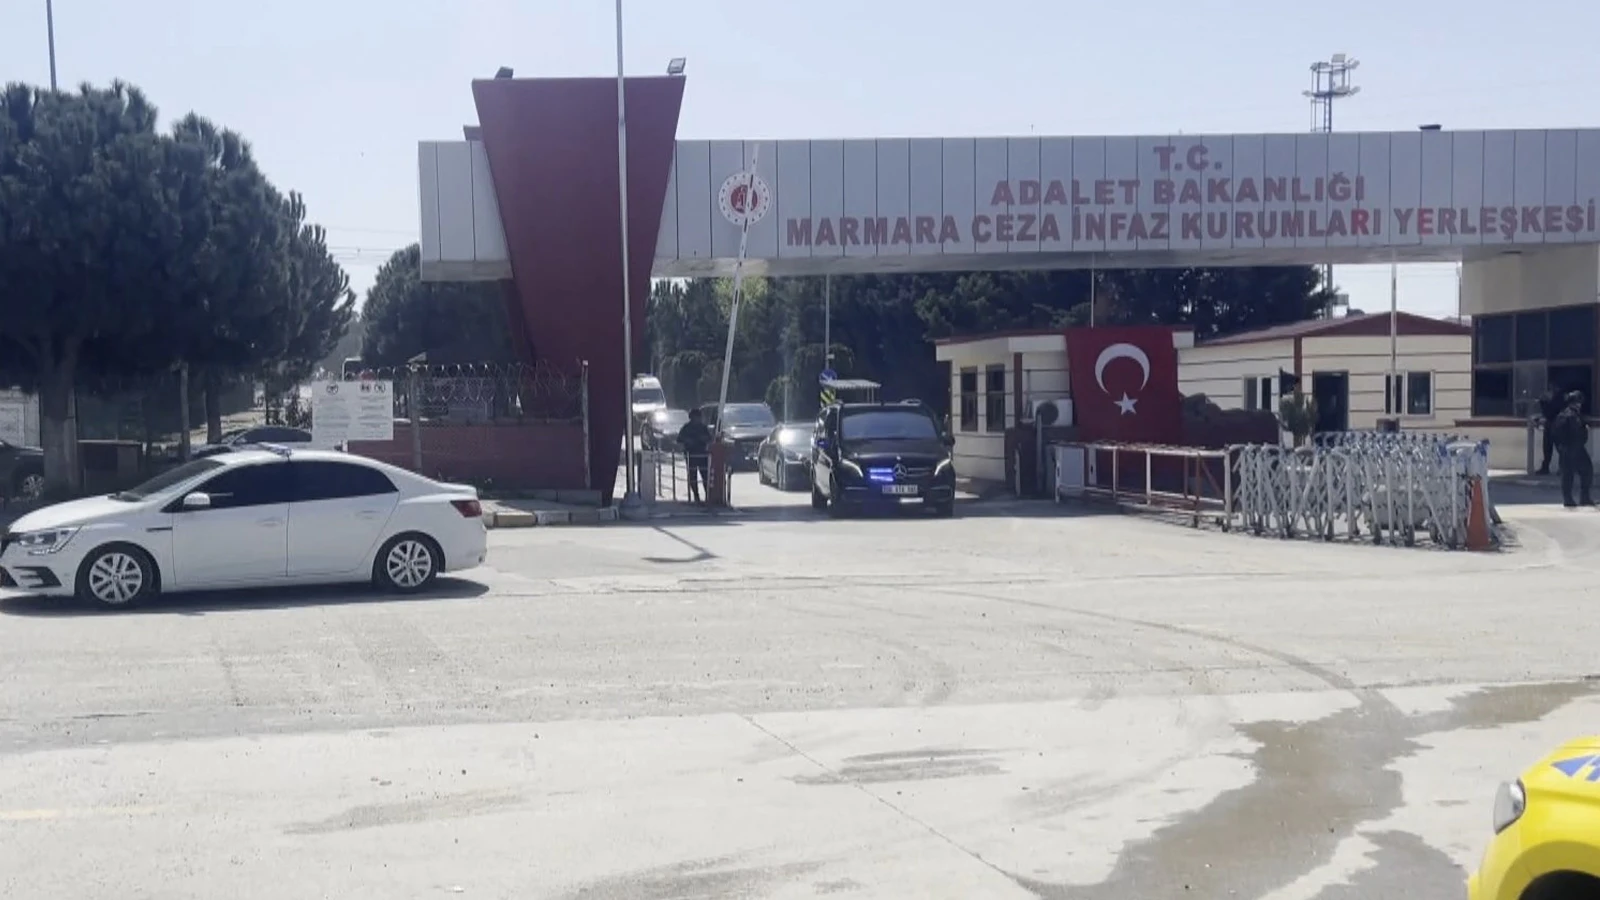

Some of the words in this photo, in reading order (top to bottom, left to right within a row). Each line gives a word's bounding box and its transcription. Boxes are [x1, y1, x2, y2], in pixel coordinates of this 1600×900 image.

[1153, 144, 1222, 171] T.C.
[990, 179, 1140, 205] ADALET
[1153, 172, 1365, 204] BAKANLIĞI
[787, 215, 960, 246] MARMARA
[971, 213, 1060, 243] CEZA
[1072, 206, 1169, 240] İNFAZ
[1182, 208, 1381, 239] KURUMLARI
[1393, 198, 1595, 241] YERLEŞKESİ
